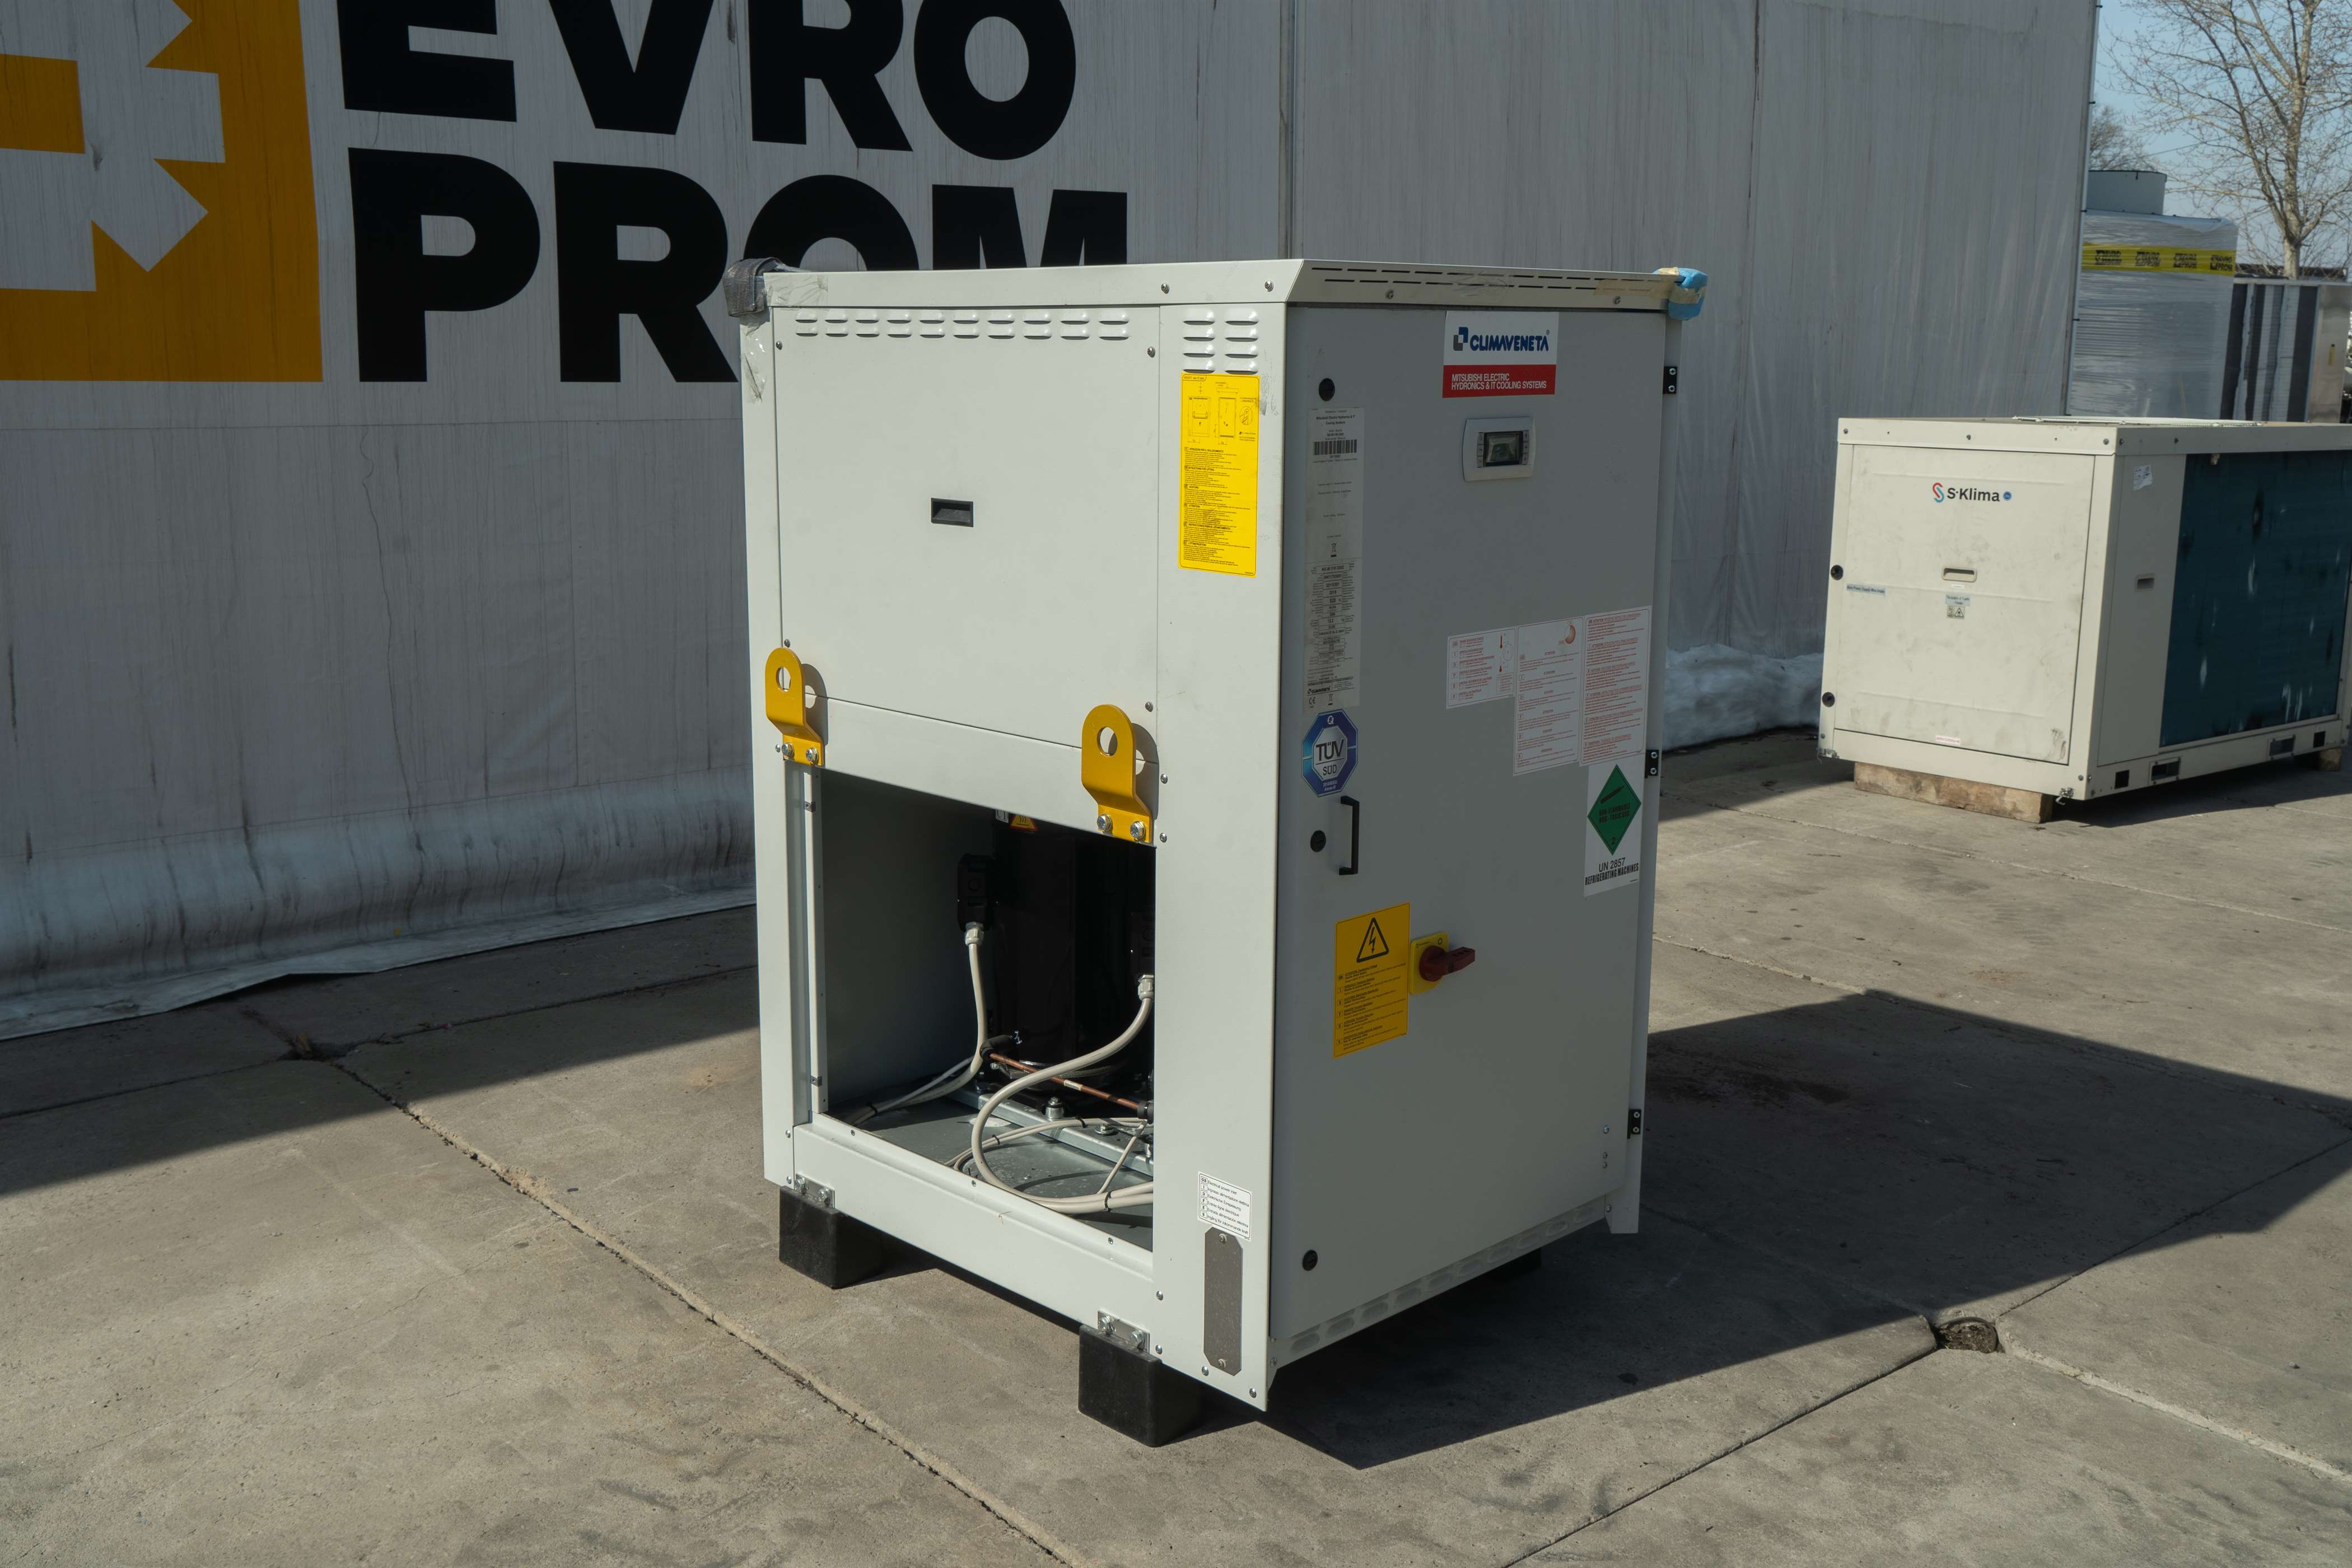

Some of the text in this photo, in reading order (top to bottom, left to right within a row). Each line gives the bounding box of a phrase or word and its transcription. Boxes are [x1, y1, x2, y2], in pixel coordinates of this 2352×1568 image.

[1470, 335, 1549, 351] CLIMAVENETA
[1327, 716, 1334, 725] Q
[1316, 739, 1344, 761] TÜV
[1323, 764, 1337, 776] SÜD
[1611, 837, 1616, 845] 2
[1599, 857, 1625, 872] UN 2857
[1585, 862, 1639, 886] REFRIGERATING MACHINES
